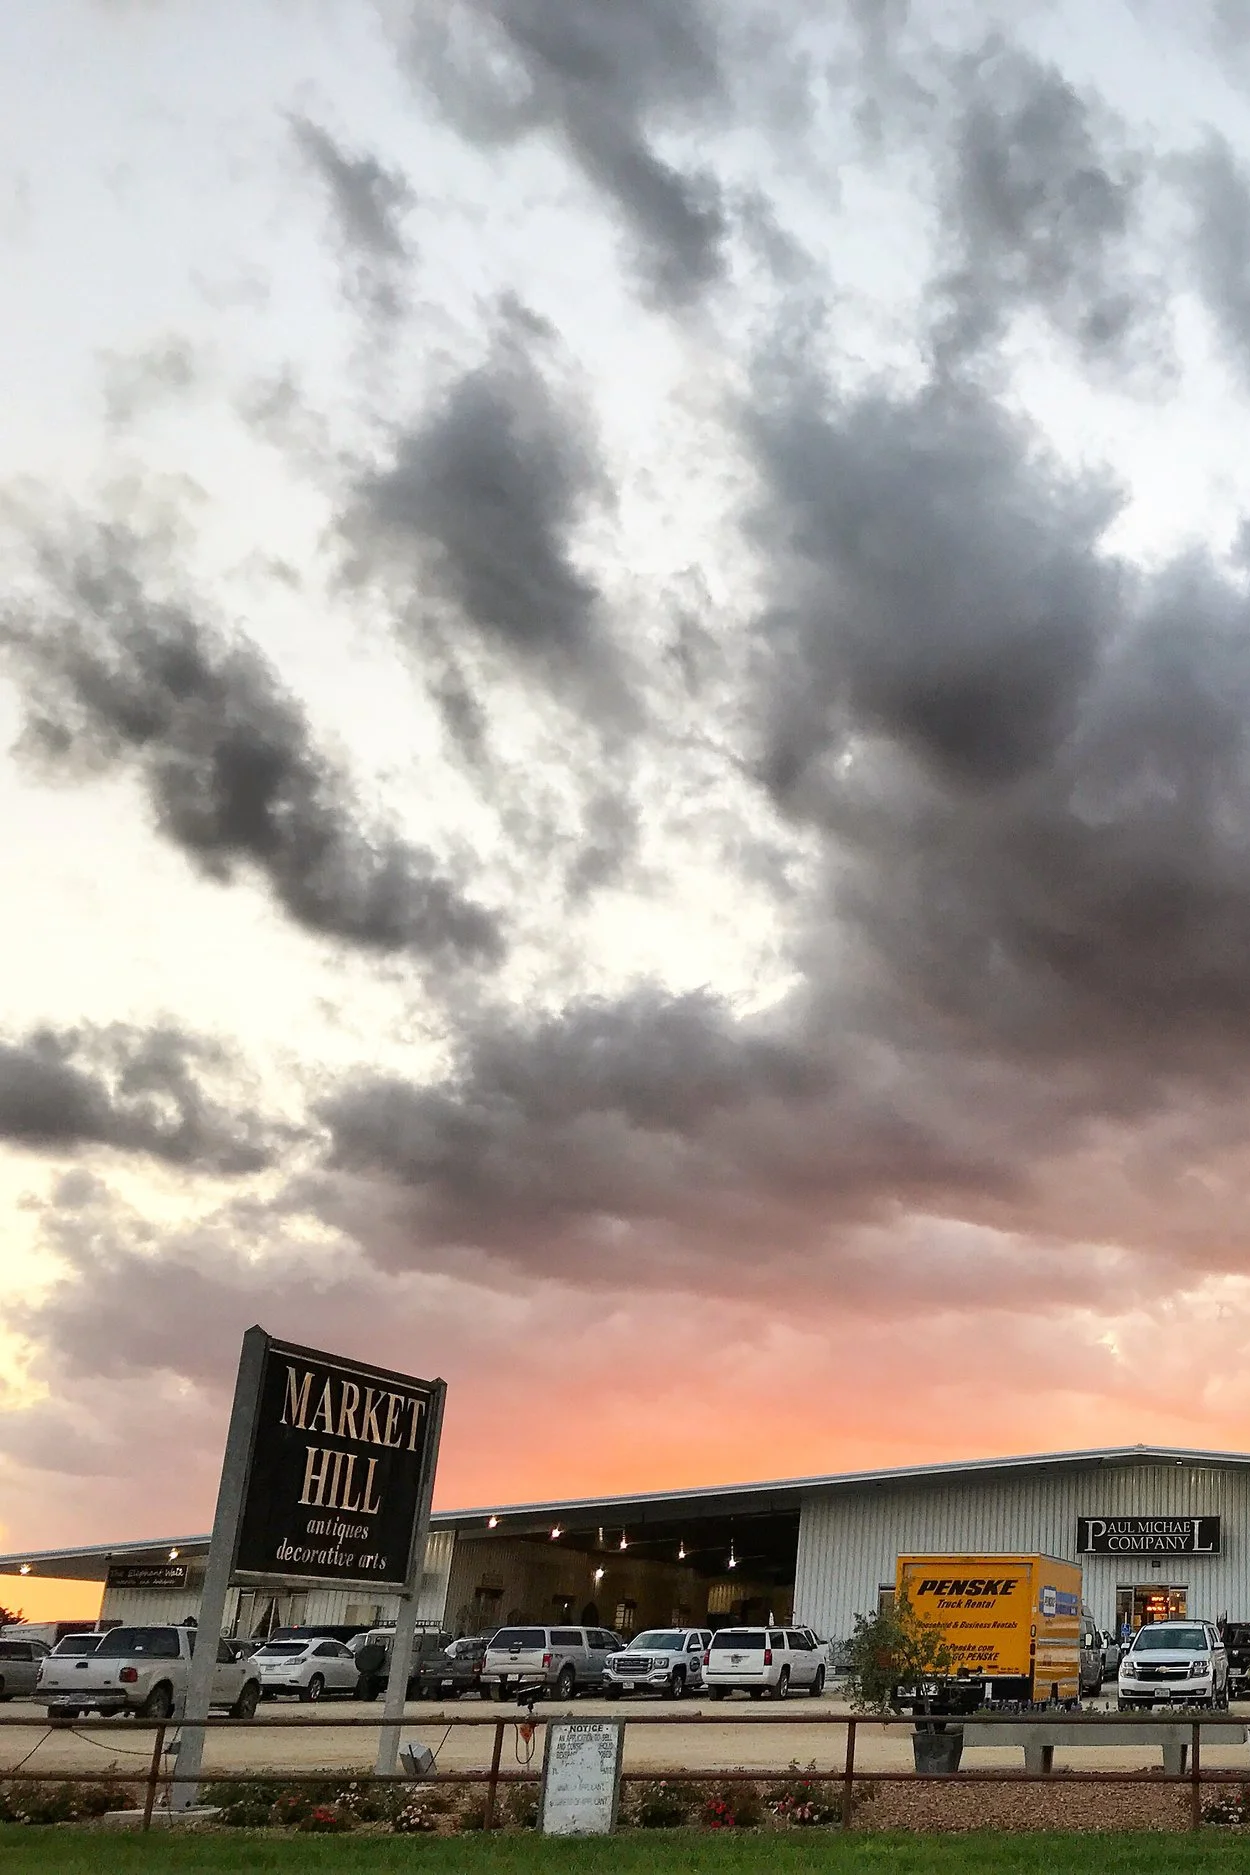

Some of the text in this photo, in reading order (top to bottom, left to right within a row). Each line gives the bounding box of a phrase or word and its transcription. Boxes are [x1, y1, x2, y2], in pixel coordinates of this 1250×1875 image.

[279, 1365, 426, 1452] MARKET
[297, 1446, 382, 1515] HILL
[306, 1516, 369, 1545] antiques
[1084, 1519, 1213, 1552] PAUL MICHAEL
[276, 1537, 387, 1570] decorative arts
[1108, 1536, 1189, 1550] COMPANY
[917, 1579, 1018, 1596] PENSKE
[936, 1599, 996, 1609] Truck Rental
[952, 1621, 959, 1629] &
[959, 1621, 990, 1629] Business
[991, 1620, 1018, 1629] Rentals
[569, 1724, 603, 1732] NOTICE
